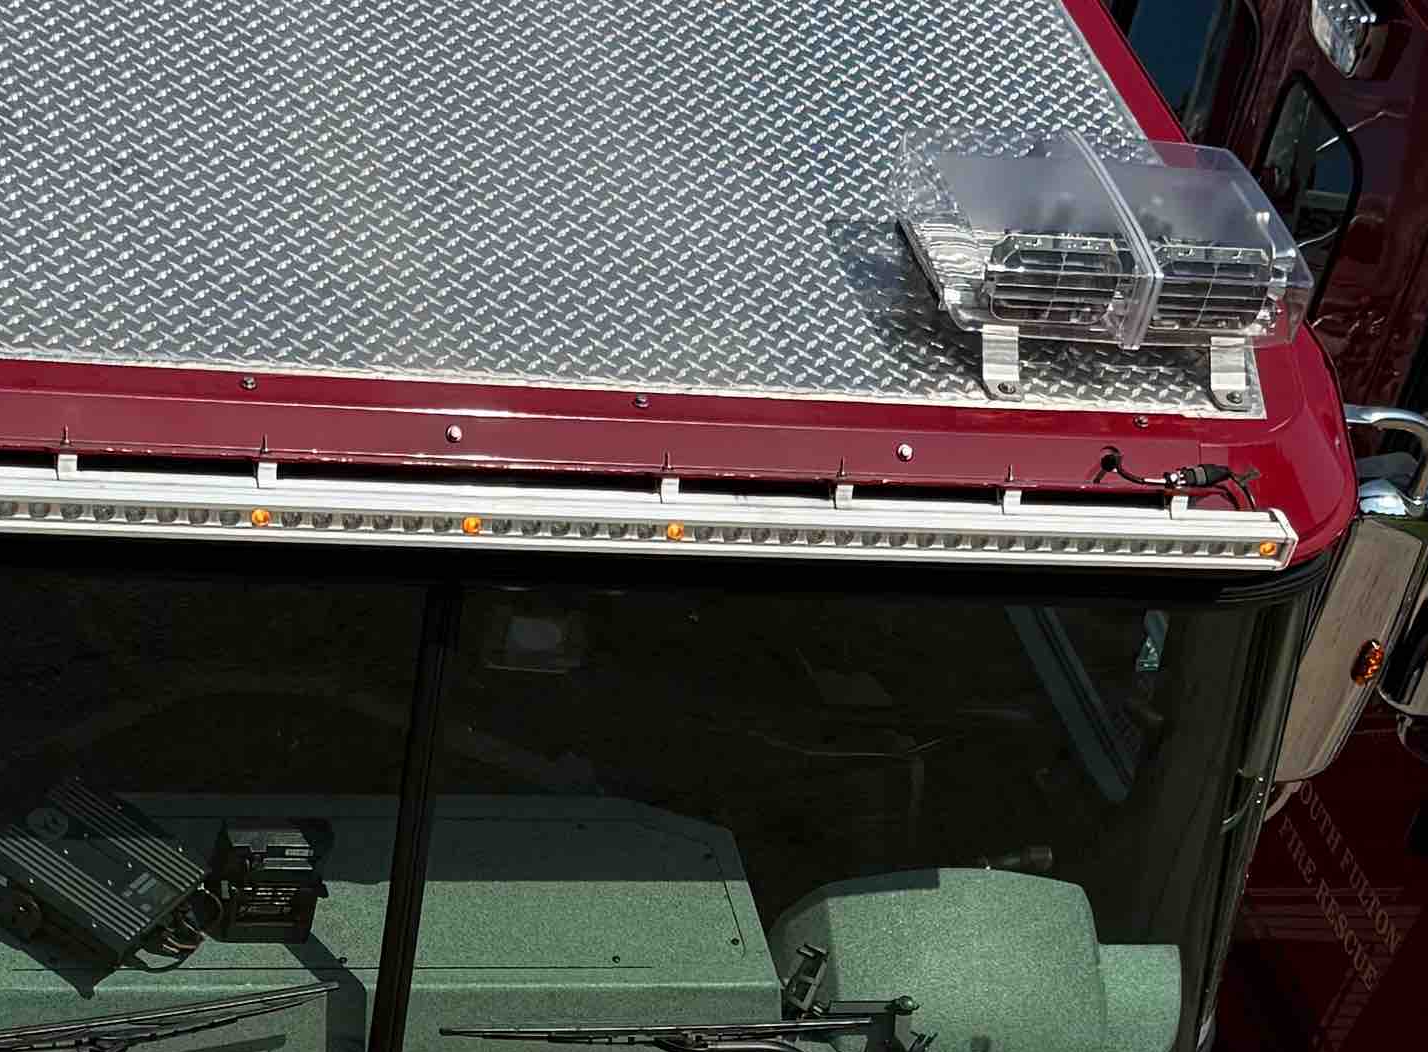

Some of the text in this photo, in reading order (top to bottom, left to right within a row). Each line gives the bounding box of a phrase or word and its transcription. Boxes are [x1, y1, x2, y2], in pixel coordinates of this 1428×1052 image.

[1299, 780, 1404, 956] OUTH FULTON
[1316, 877, 1380, 991] RESCUE
